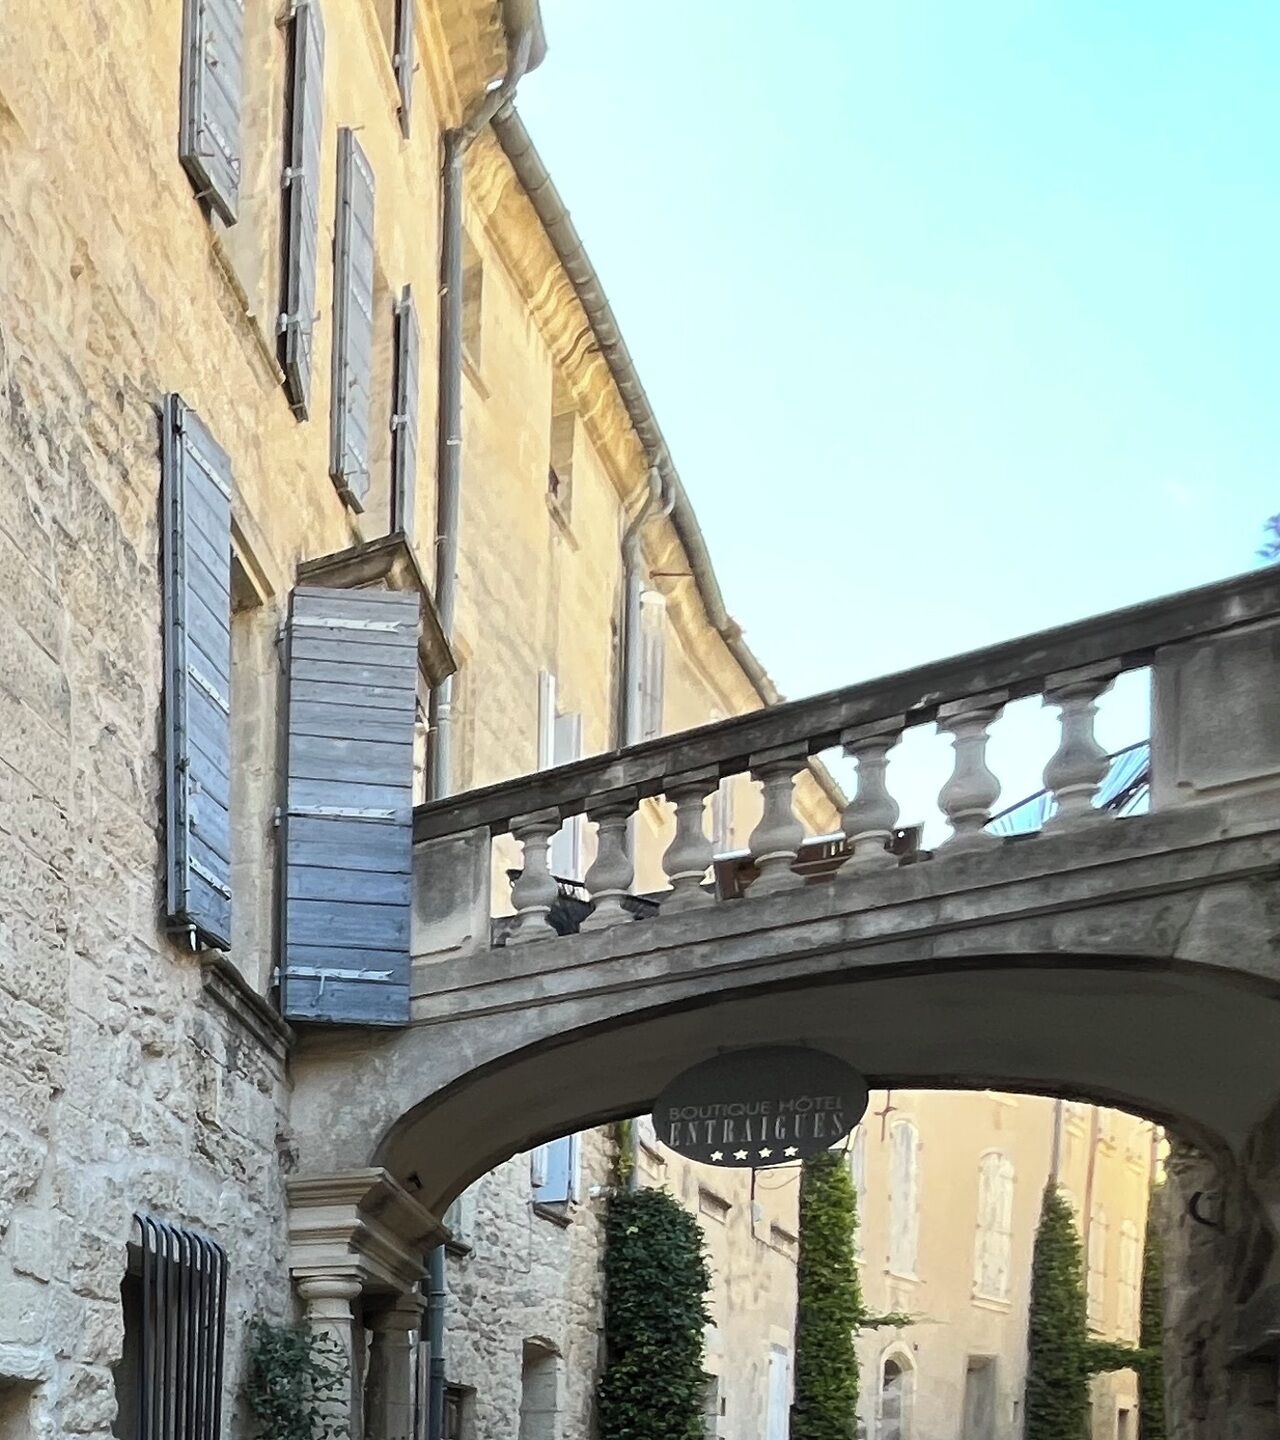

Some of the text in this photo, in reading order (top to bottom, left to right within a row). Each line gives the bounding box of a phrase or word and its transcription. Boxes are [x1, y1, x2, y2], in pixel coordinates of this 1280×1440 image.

[669, 1095, 843, 1121] BOUTIQUE HÔTEL
[669, 1112, 845, 1147] ENTRAIGUES
